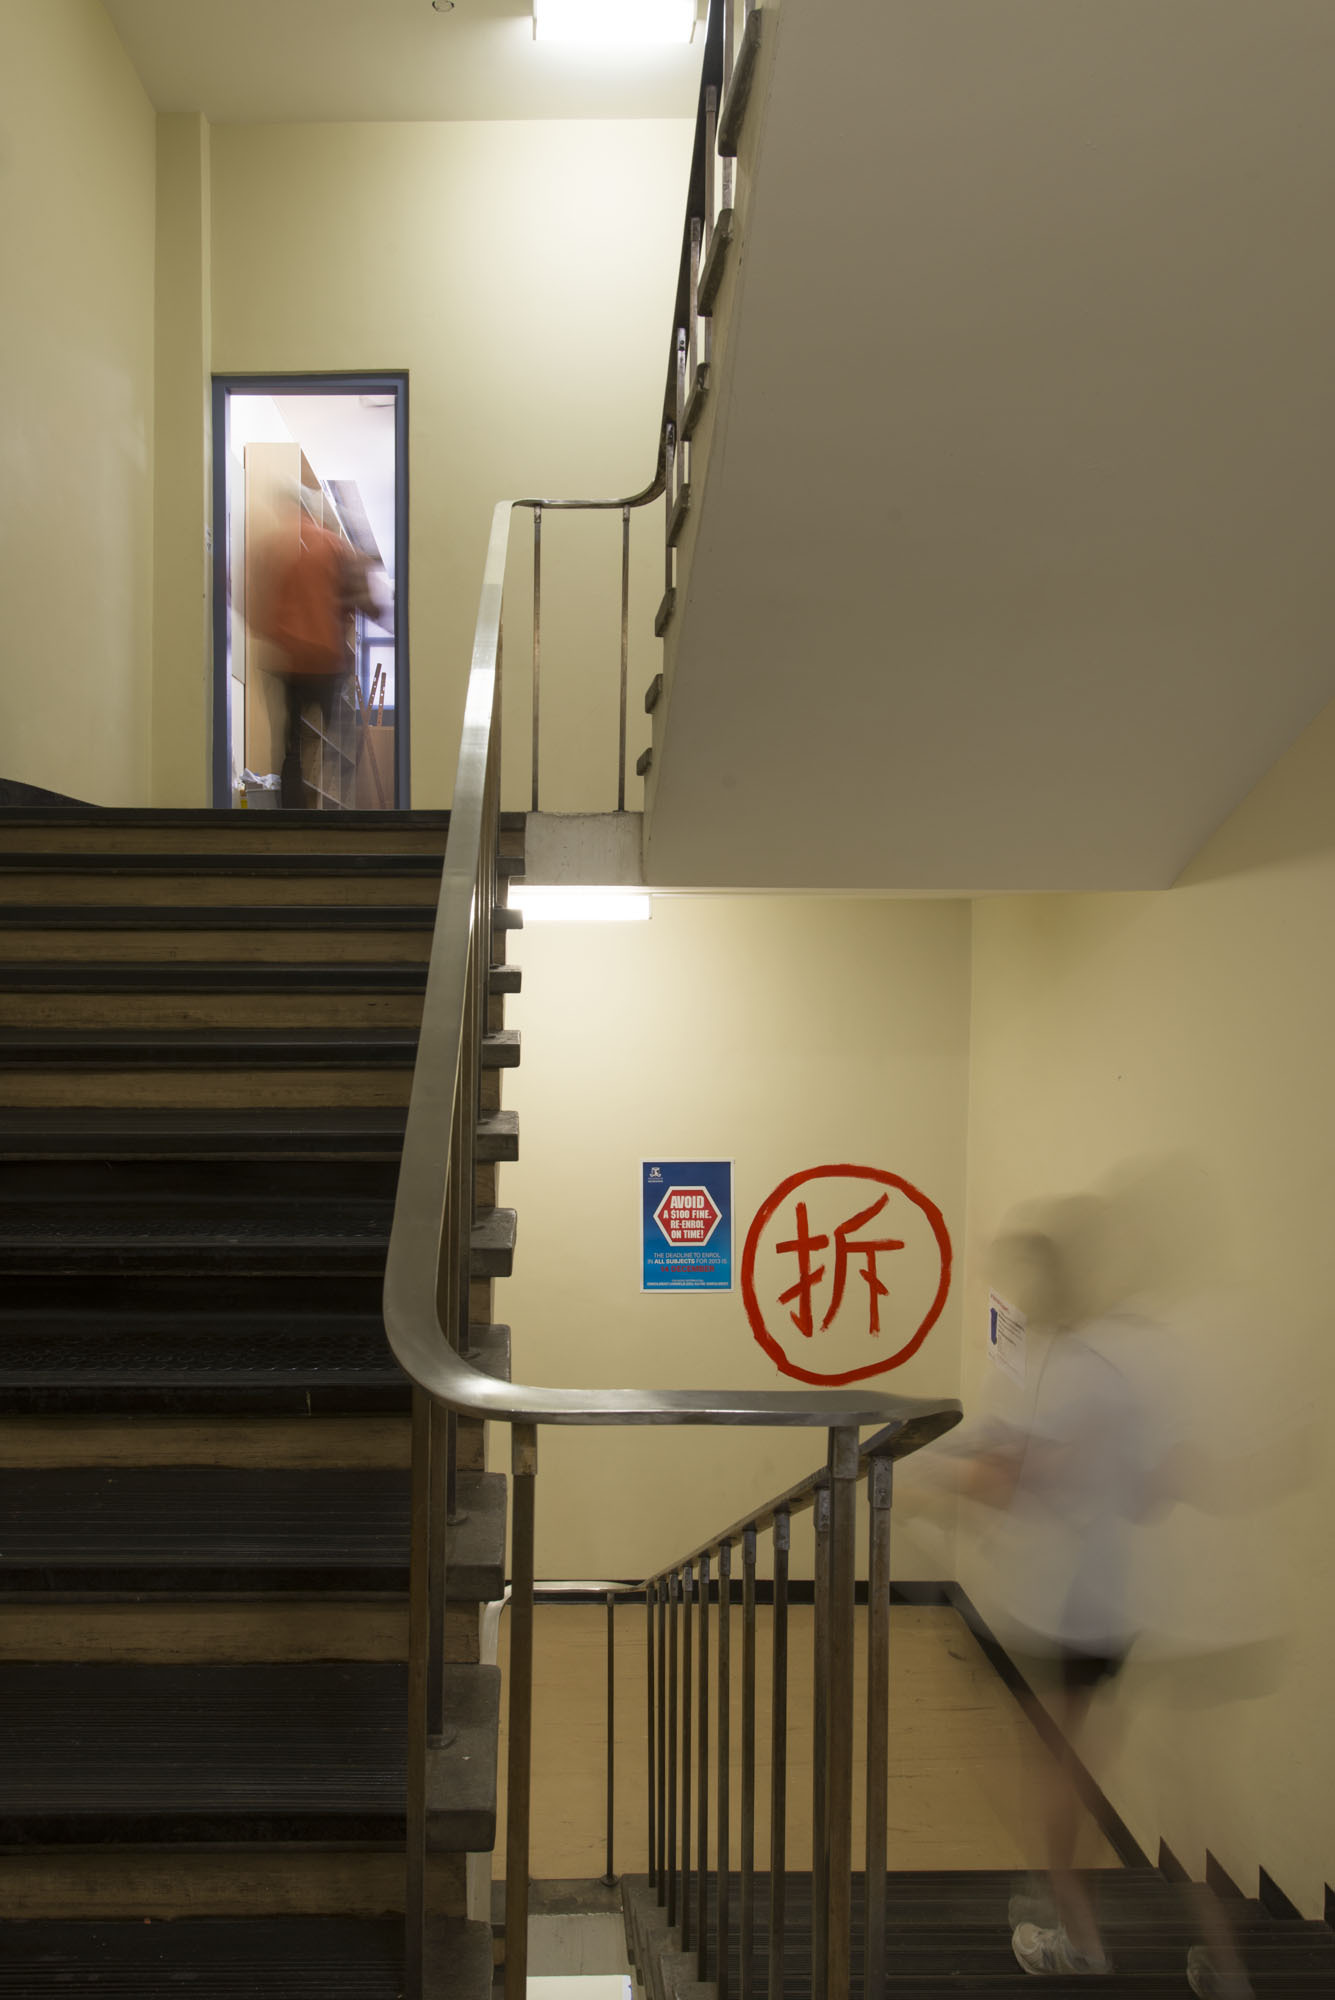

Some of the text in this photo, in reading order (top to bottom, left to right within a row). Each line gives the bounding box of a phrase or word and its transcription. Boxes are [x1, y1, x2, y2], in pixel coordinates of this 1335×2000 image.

[670, 1196, 705, 1209] AVOID
[663, 1209, 712, 1219] A $100 FINE.
[670, 1220, 705, 1229] RE-ENROL
[671, 1230, 704, 1239] ON TIME!
[776, 1192, 905, 1337] 拆
